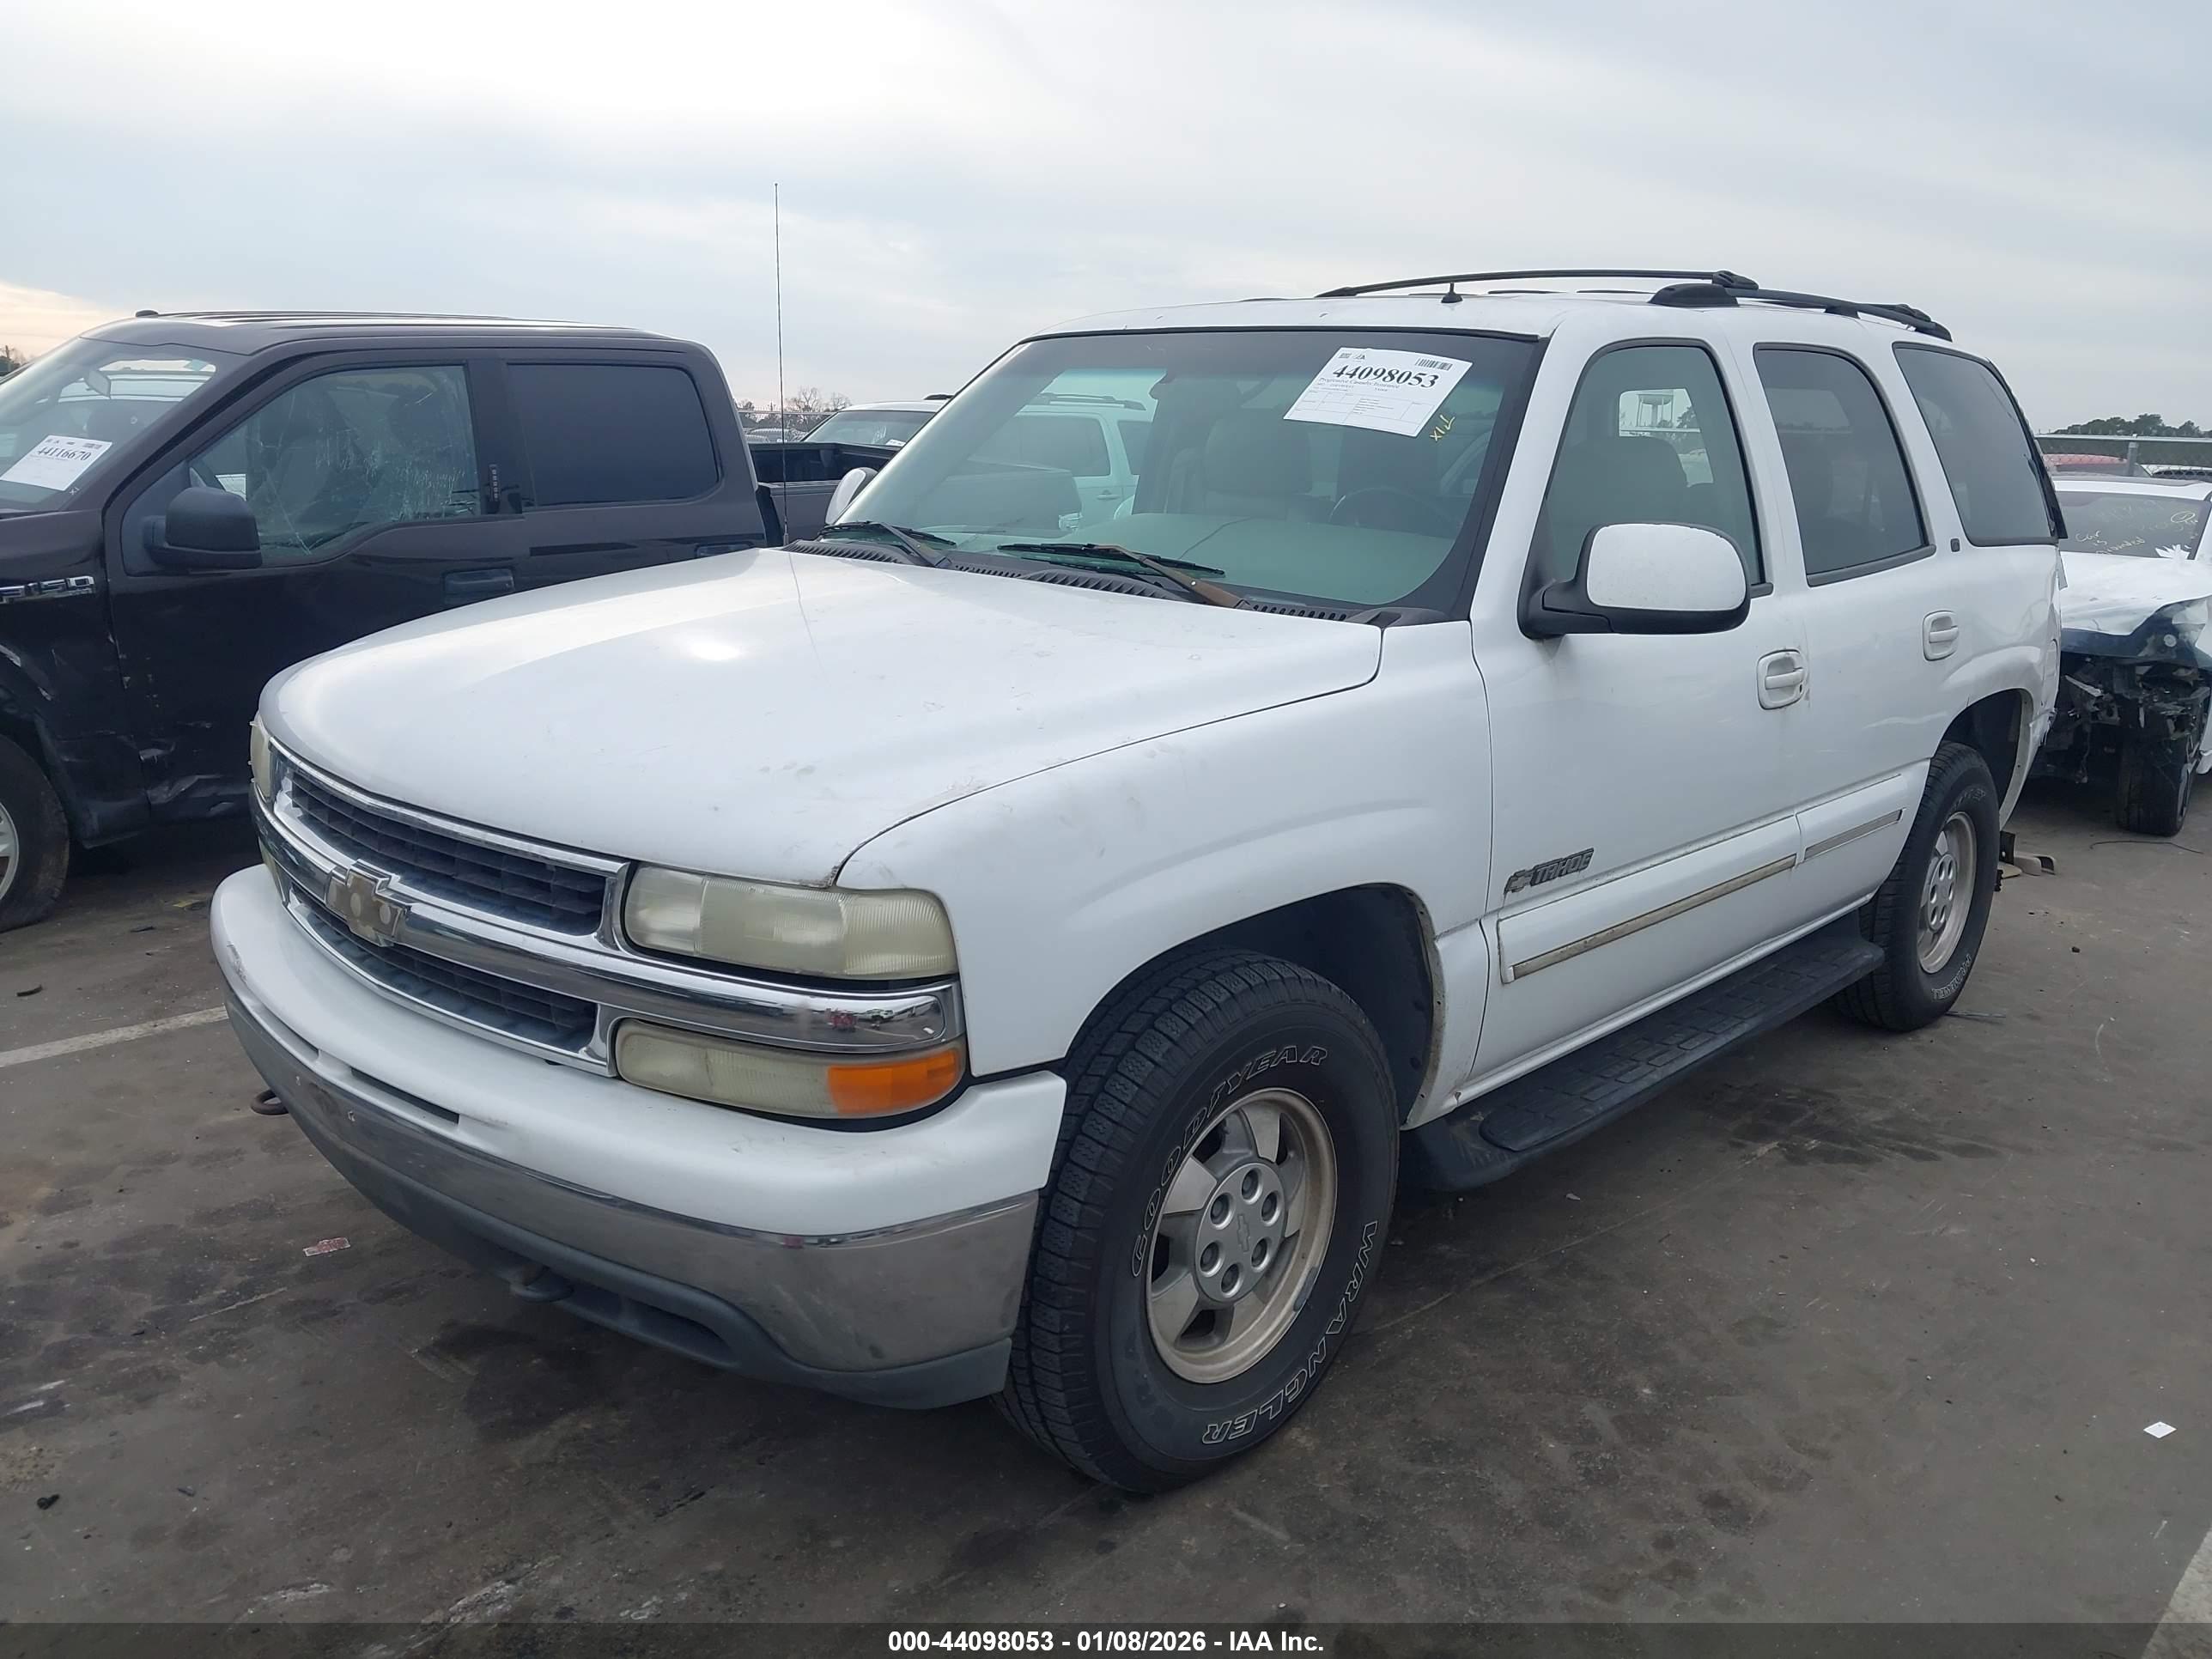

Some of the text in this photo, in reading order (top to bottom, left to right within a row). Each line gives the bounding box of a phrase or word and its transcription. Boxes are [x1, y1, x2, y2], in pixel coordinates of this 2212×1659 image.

[1333, 364, 1439, 389] 44098053
[38, 446, 92, 461] 44116670
[1131, 1044, 1328, 1279] GOODYEAR
[1201, 1219, 1379, 1446] WRANGLER
